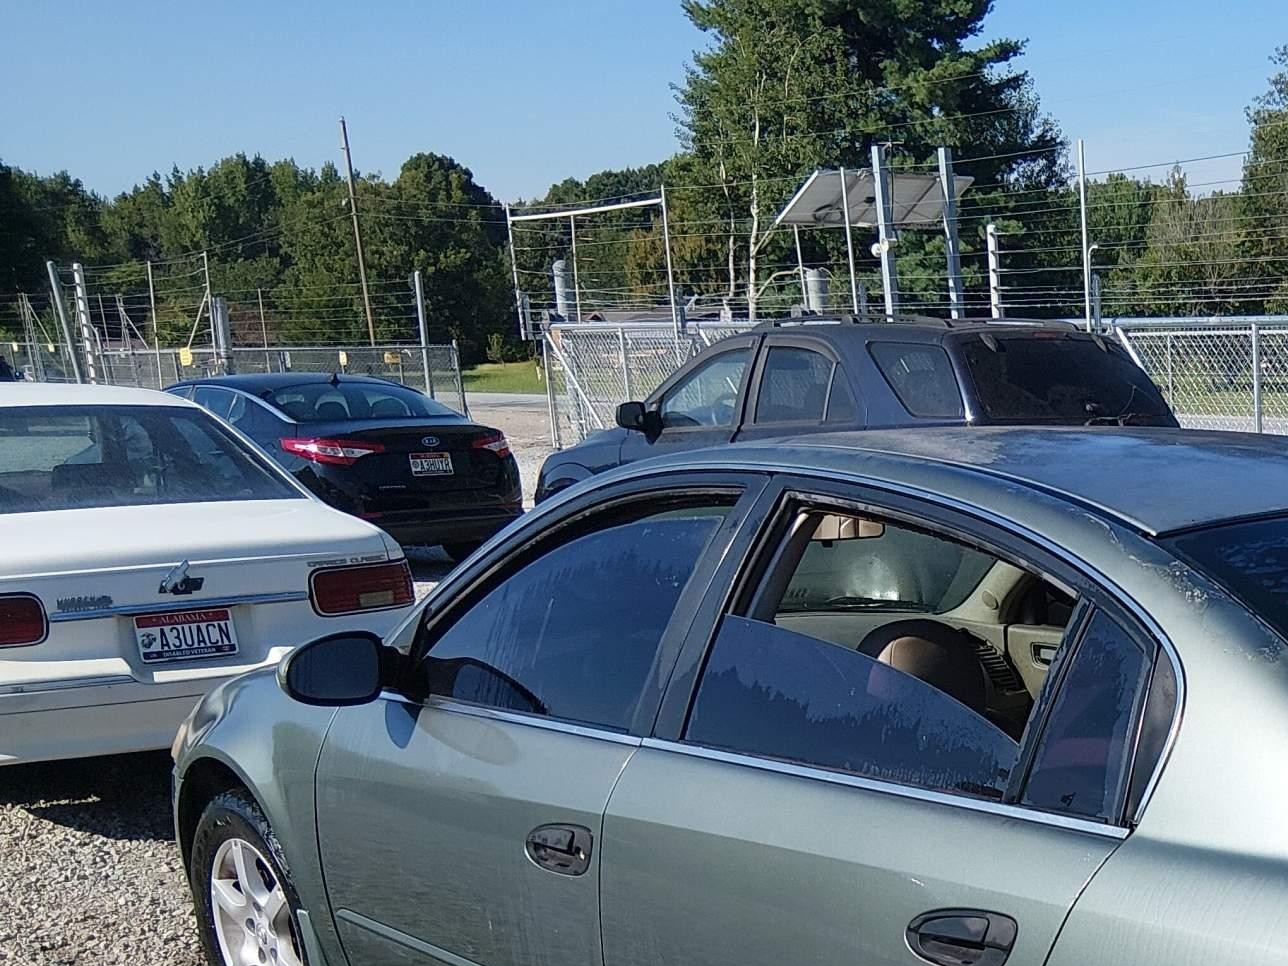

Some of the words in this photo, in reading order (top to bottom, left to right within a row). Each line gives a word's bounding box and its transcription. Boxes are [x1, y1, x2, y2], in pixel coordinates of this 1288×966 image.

[160, 612, 208, 624] ALABAMA
[159, 622, 232, 650] A3UACN
[162, 649, 191, 658] DISABLED
[190, 647, 216, 655] VETERAN
